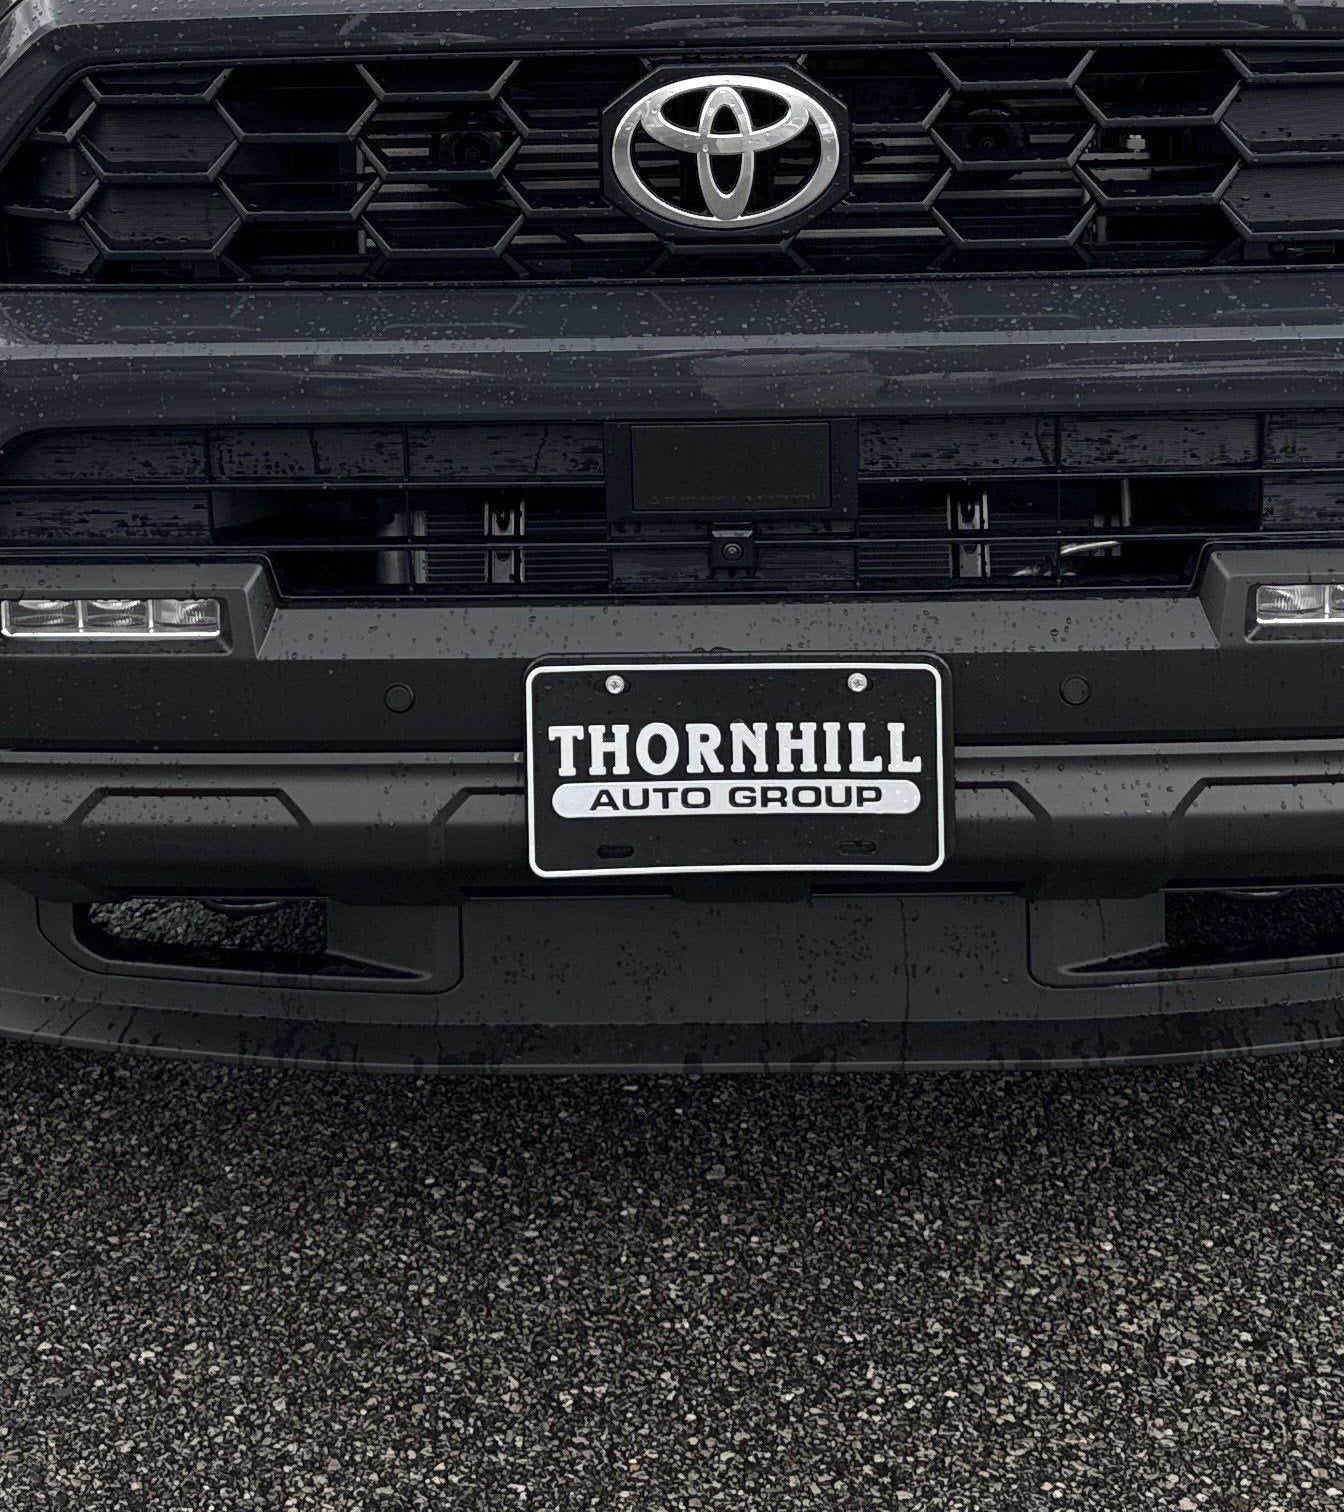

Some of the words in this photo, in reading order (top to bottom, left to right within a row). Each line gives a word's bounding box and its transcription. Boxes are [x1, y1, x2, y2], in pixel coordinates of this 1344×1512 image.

[548, 721, 922, 777] THORNHILL
[589, 787, 712, 812] AUTO
[728, 785, 883, 809] GROUP
